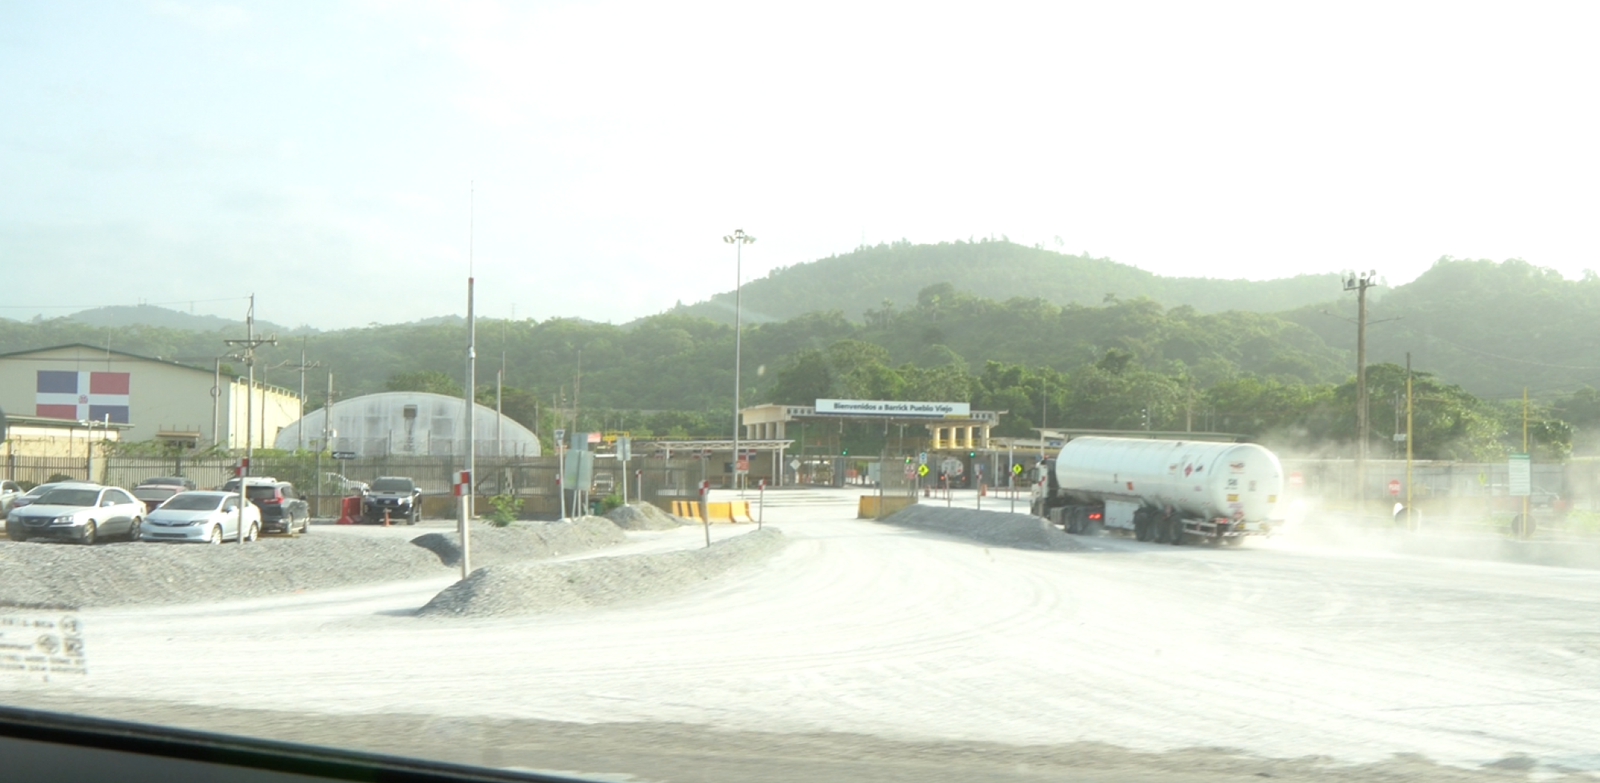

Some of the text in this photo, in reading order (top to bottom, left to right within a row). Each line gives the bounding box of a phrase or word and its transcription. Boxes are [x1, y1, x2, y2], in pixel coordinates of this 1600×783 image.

[884, 403, 908, 412] Barrick
[910, 404, 934, 413] Pueblo
[935, 405, 952, 413] Viejo
